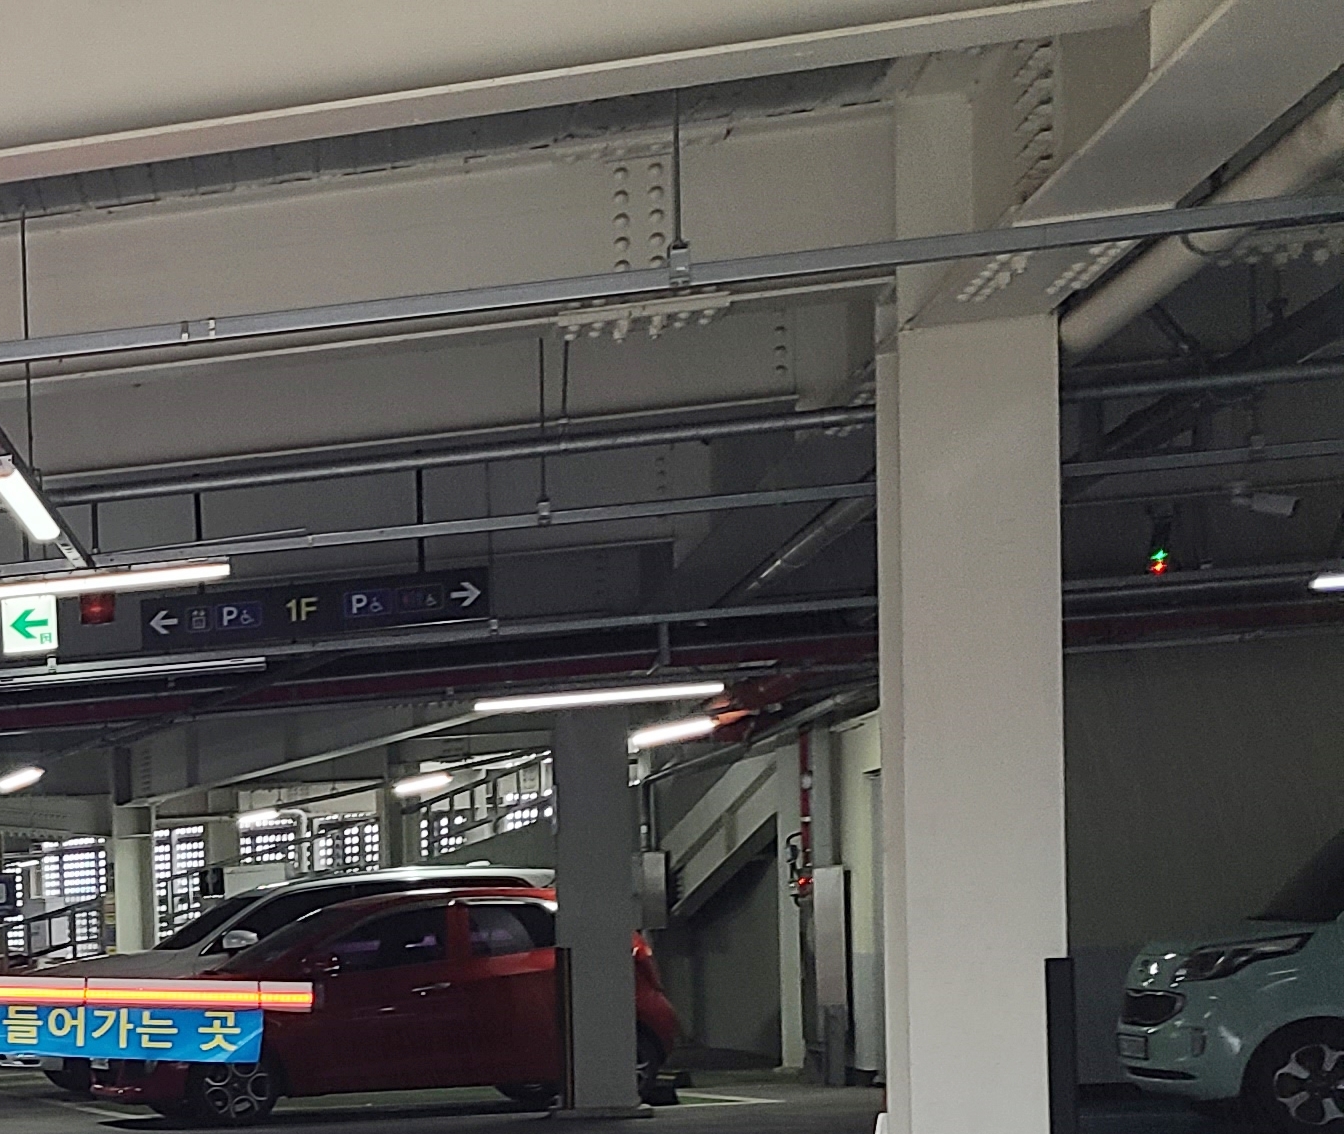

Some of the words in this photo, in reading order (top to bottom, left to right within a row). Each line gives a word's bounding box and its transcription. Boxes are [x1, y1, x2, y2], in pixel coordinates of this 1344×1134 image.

[285, 597, 319, 622] 1F
[0, 1004, 179, 1050] 들어가는
[197, 1010, 242, 1052] 곳
